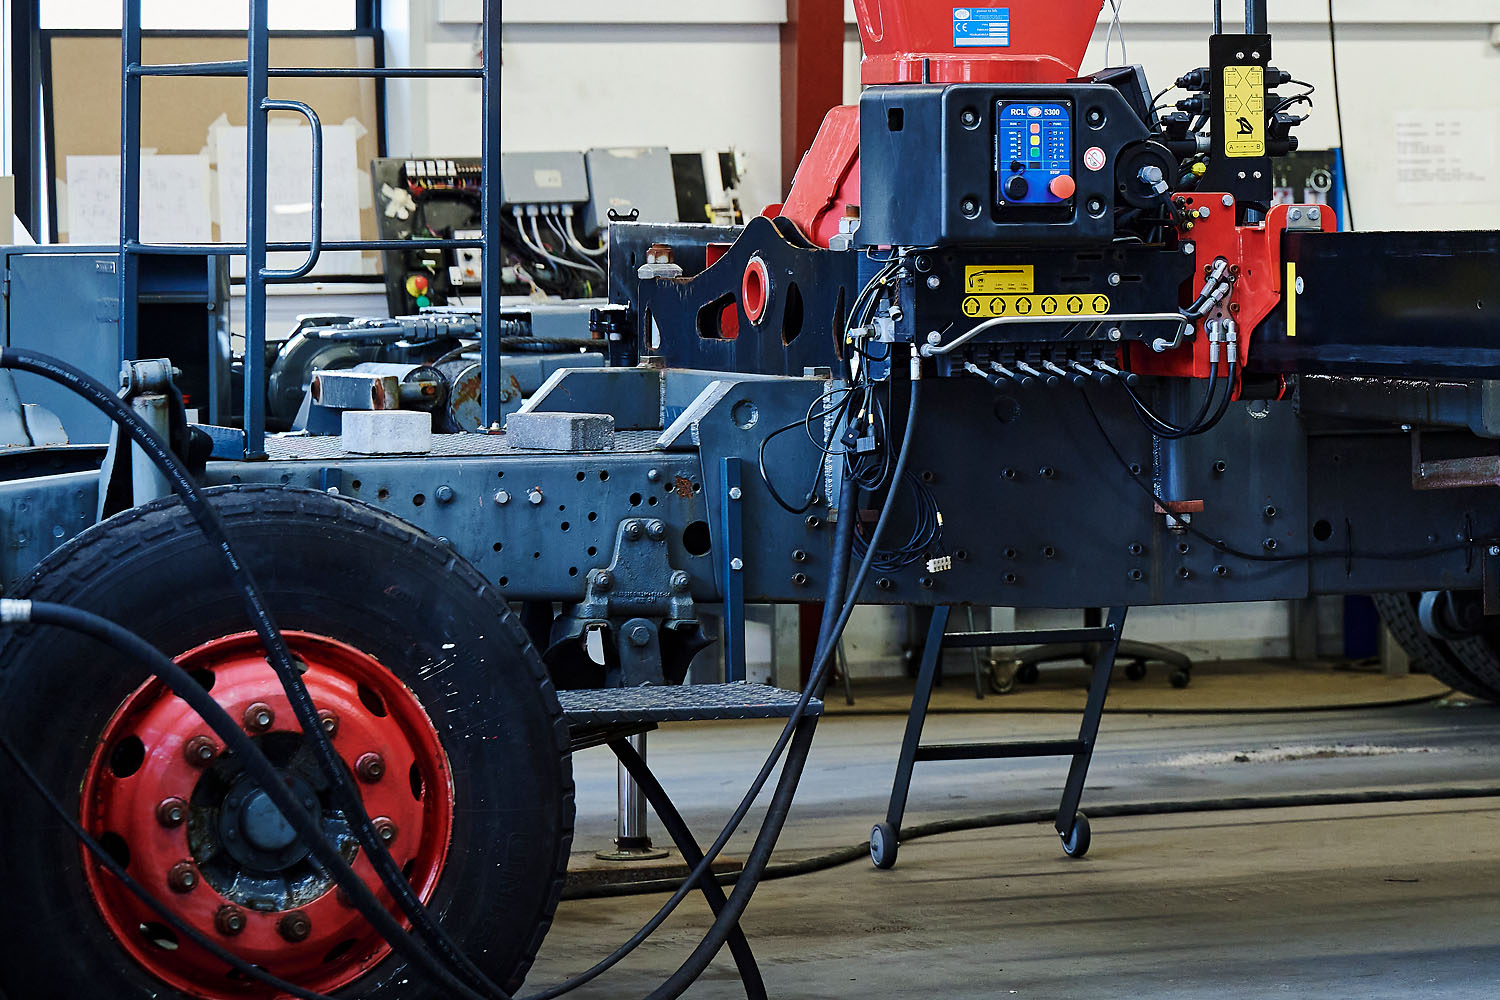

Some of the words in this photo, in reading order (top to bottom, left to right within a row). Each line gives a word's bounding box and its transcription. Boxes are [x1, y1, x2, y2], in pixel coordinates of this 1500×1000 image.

[955, 22, 968, 32] CE
[1010, 108, 1026, 116] RCL
[1044, 108, 1061, 116] 5300
